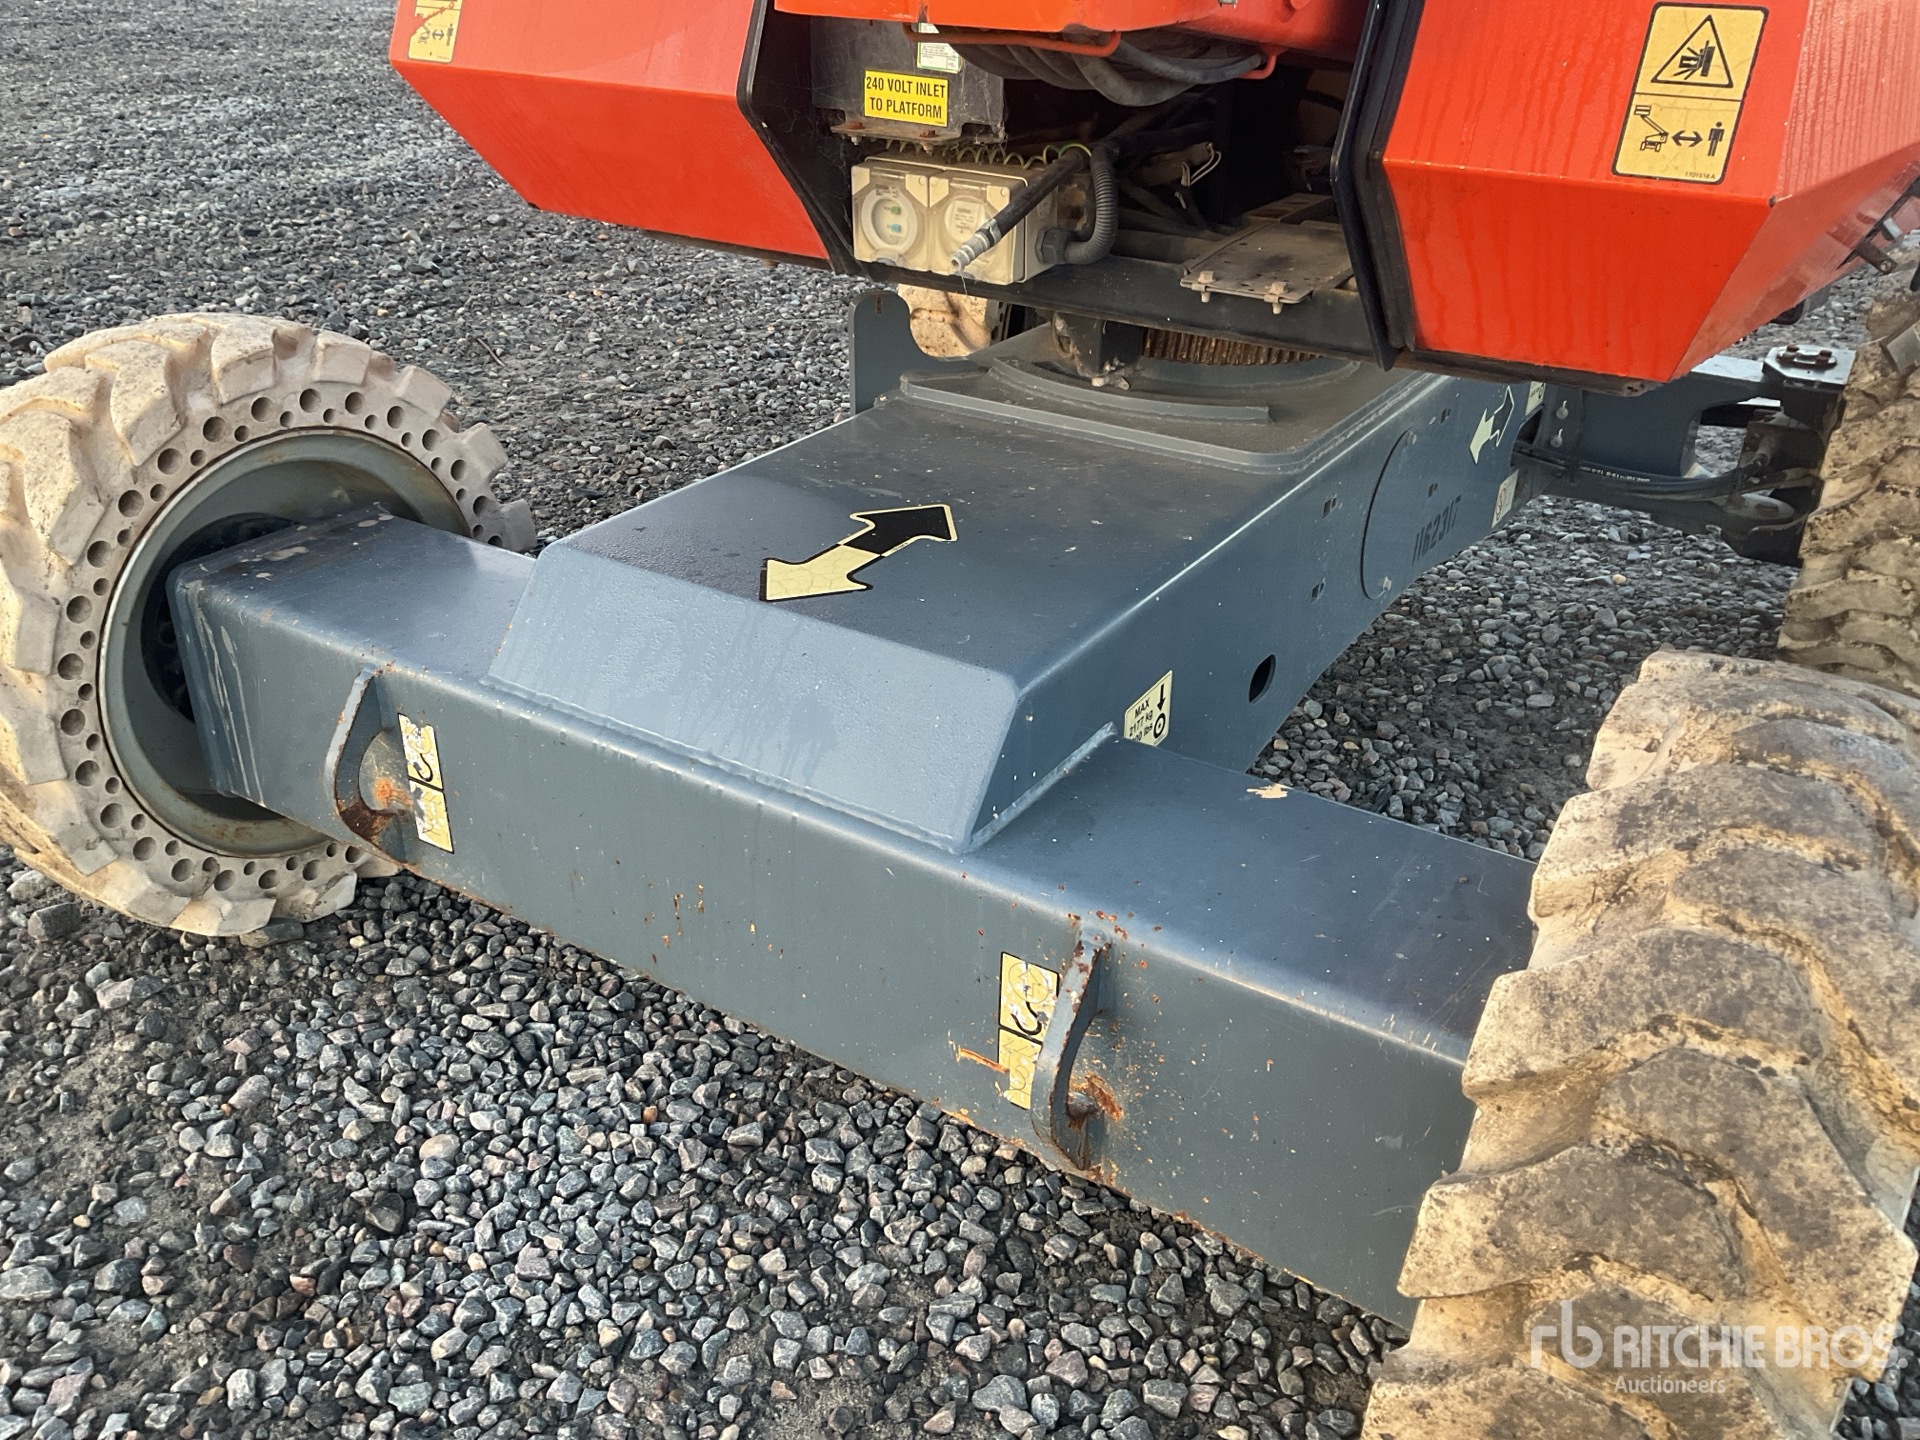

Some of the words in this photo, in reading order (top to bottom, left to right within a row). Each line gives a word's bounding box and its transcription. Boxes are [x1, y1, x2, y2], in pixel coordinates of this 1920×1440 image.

[866, 76, 884, 91] 240
[887, 79, 912, 94] VOLT
[915, 82, 946, 98] INLET
[869, 97, 883, 111] TO
[886, 99, 942, 119] PLATFORM
[1135, 699, 1150, 719] MAX
[1129, 716, 1144, 737] 2177
[1146, 709, 1153, 722] kg
[1144, 723, 1153, 736] lbs
